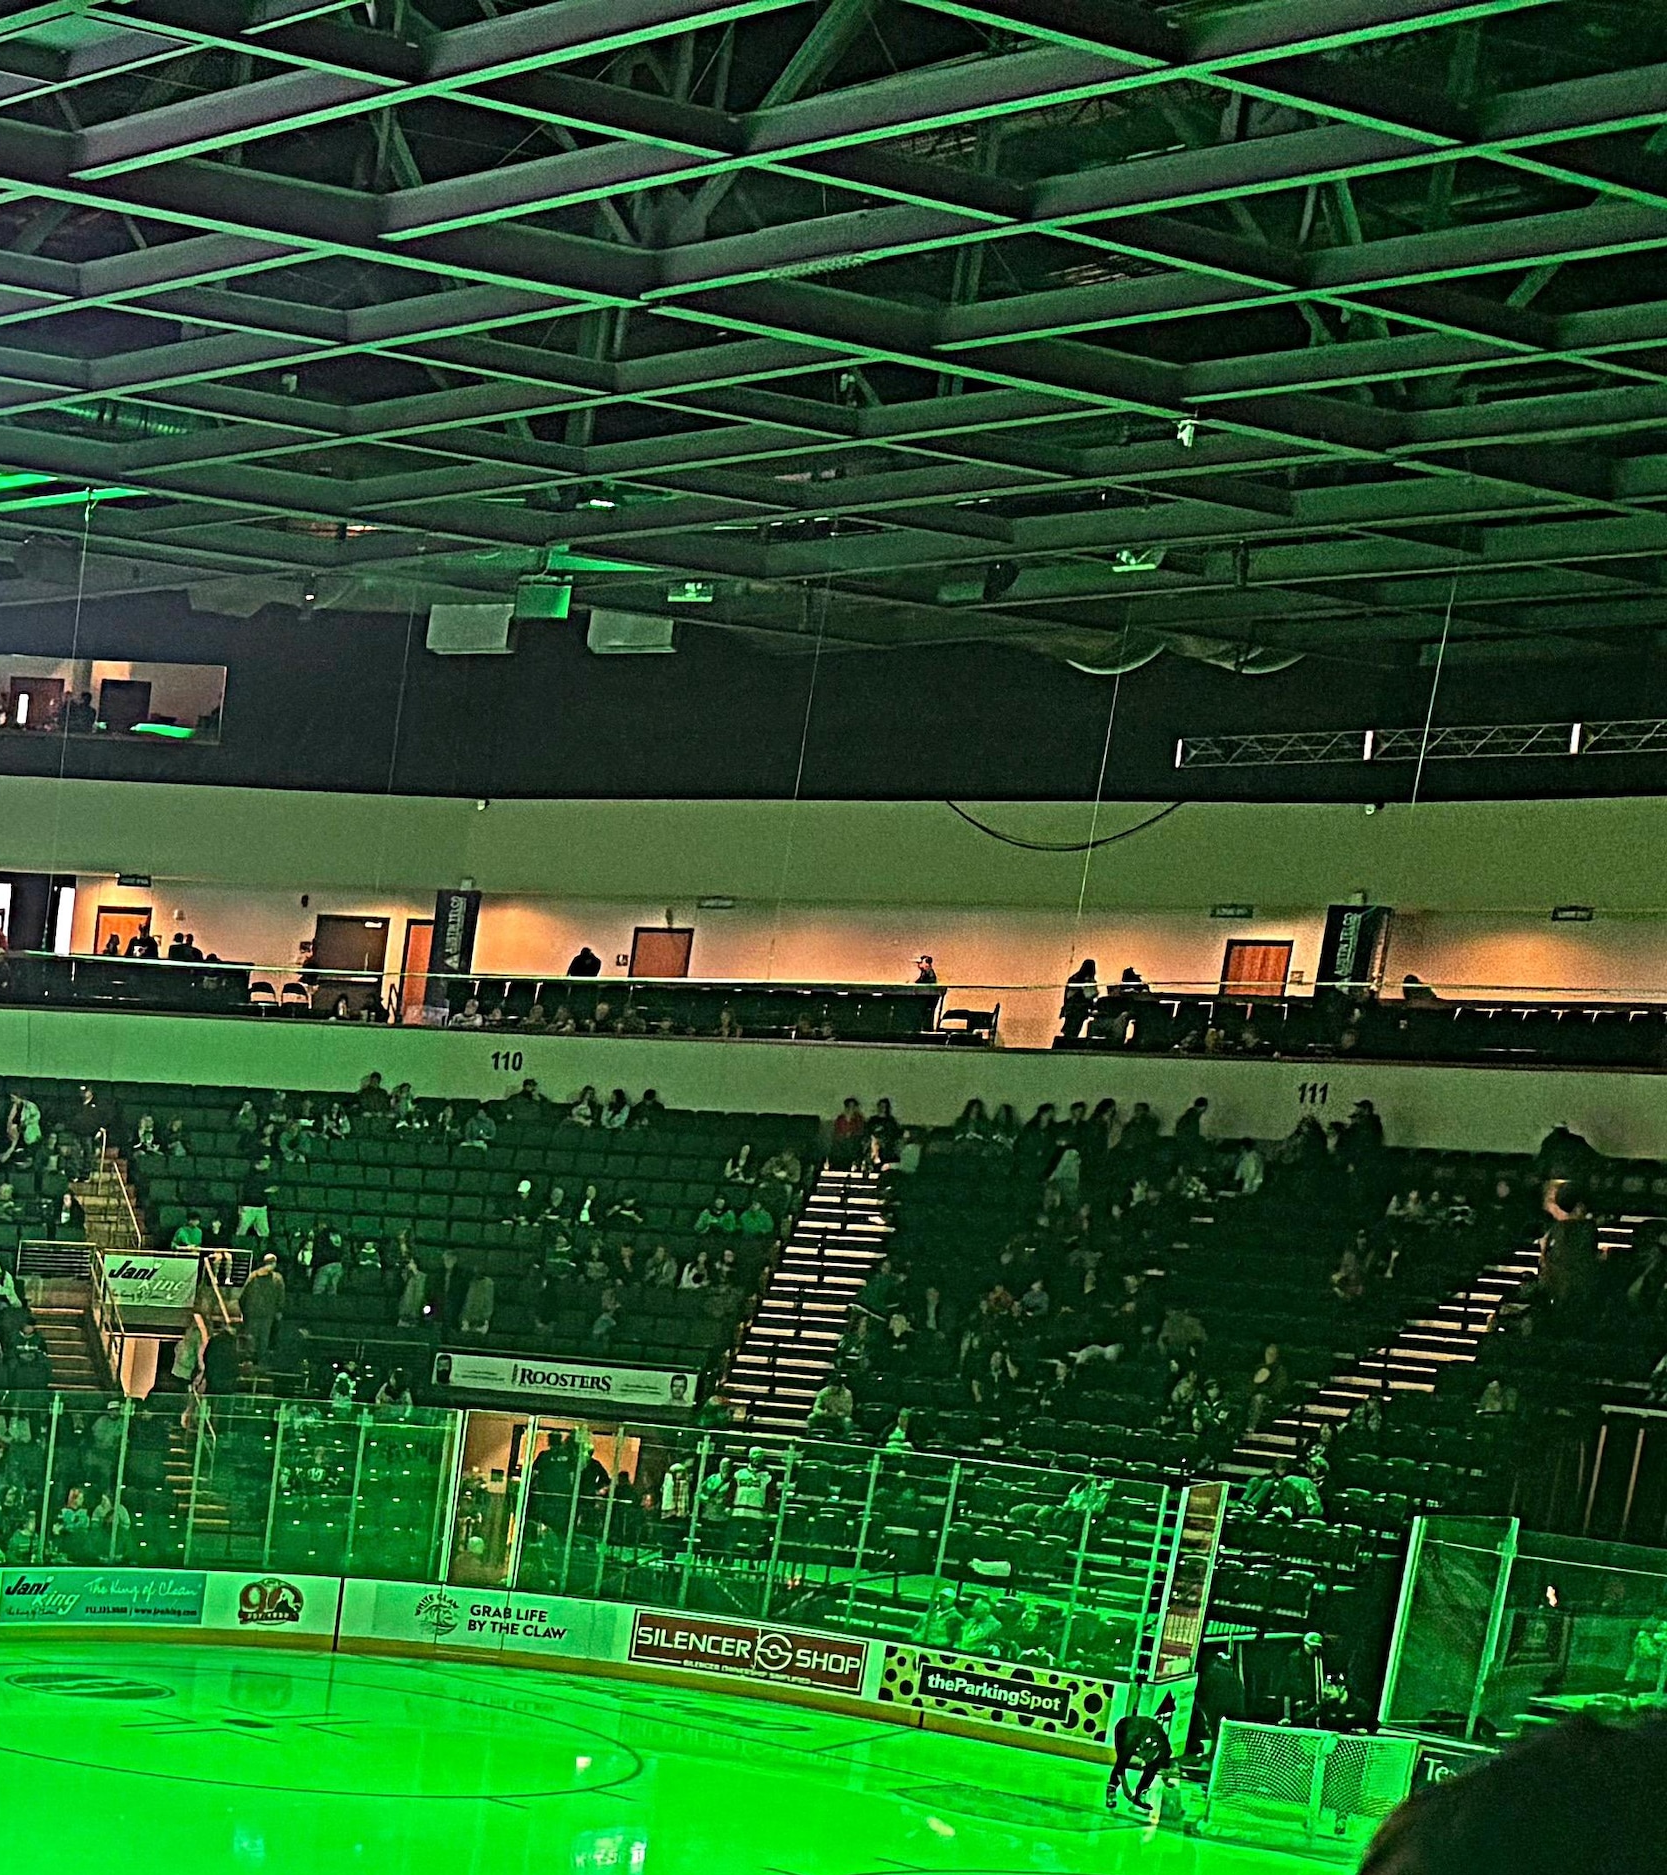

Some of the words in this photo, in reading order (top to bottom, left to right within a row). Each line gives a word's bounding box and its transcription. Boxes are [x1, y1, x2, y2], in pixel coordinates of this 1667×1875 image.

[490, 1050, 524, 1072] 110
[1298, 1081, 1330, 1105] 111
[108, 1260, 162, 1281] Jani
[520, 1367, 612, 1392] ROOSTERS
[5, 1576, 52, 1597] Jani
[470, 1604, 512, 1619] GRAB
[517, 1609, 548, 1623] LIFE
[468, 1619, 486, 1632] BY
[491, 1621, 519, 1636] THE
[522, 1624, 567, 1640] CLAW
[636, 1626, 751, 1660] SILENCER
[795, 1648, 861, 1675] SHOP
[927, 1672, 1062, 1713] theParkingSpot
